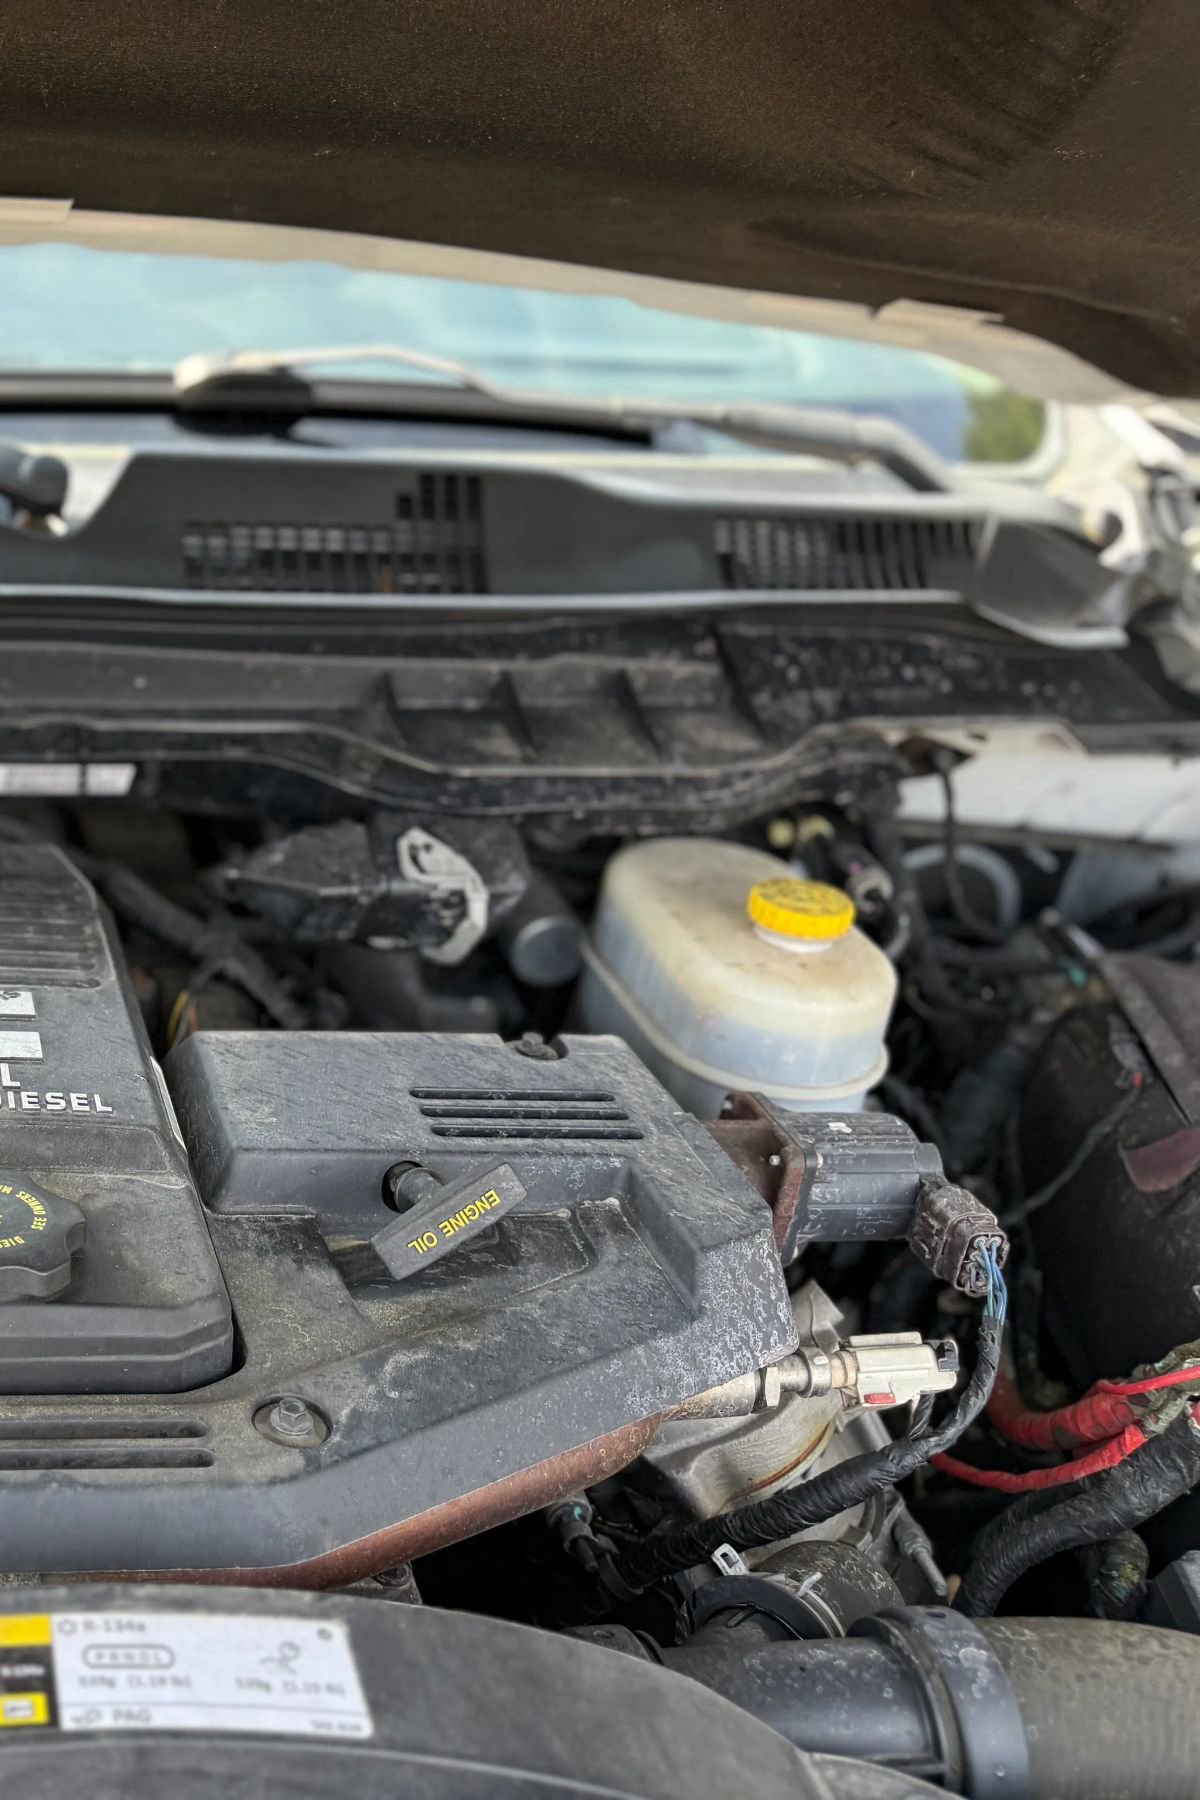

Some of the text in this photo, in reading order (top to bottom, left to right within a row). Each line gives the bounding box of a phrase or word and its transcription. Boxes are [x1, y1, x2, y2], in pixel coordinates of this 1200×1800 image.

[15, 1190, 47, 1216] OWNERS
[30, 1216, 47, 1231] SEE
[406, 1189, 502, 1254] ENGINE OIL
[83, 1619, 147, 1632] R-134a
